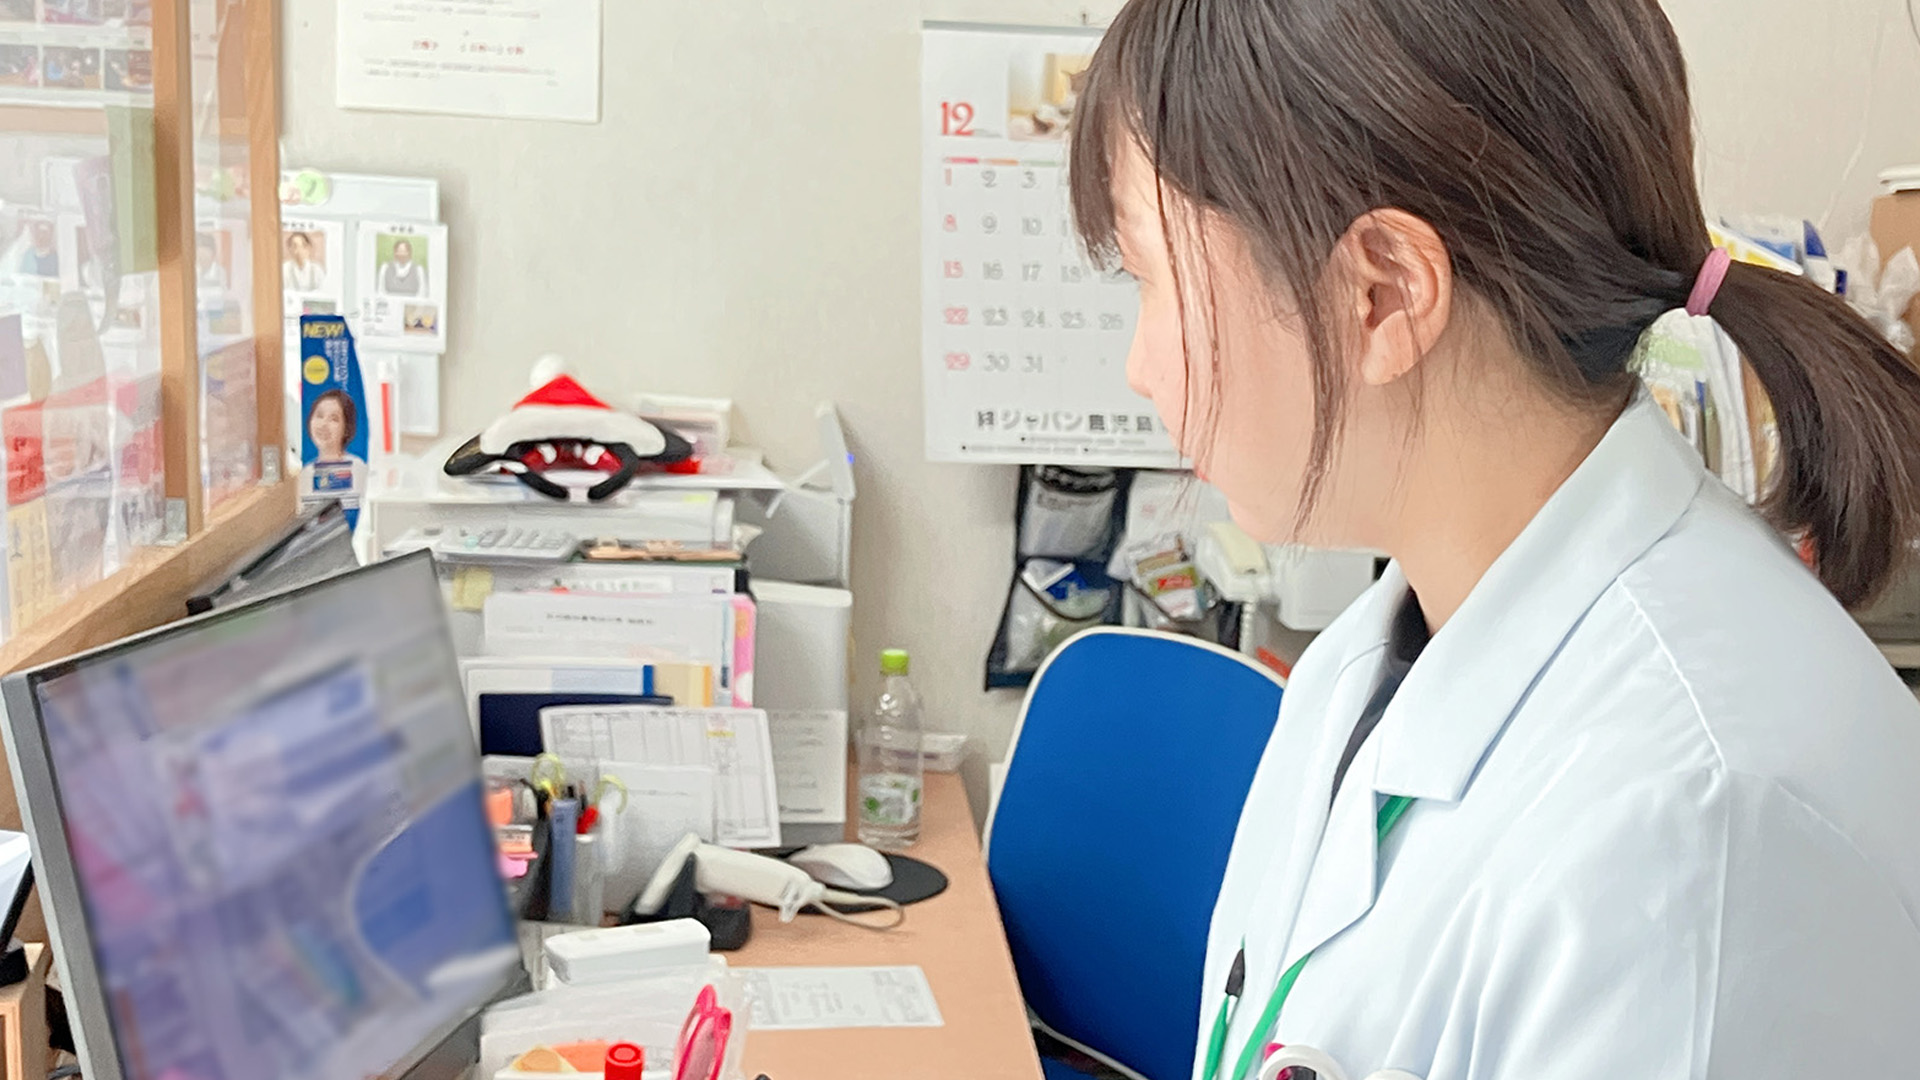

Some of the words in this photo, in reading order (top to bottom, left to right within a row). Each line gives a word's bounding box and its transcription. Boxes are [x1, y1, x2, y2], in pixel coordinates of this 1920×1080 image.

[941, 101, 975, 136] 12
[944, 168, 952, 187] 1
[981, 169, 997, 188] 2
[1021, 170, 1037, 189] 3
[981, 215, 997, 234] 9
[1022, 217, 1042, 236] 10
[983, 262, 1003, 280] 16
[1022, 263, 1042, 282] 17
[983, 308, 1008, 326] 23
[1021, 310, 1046, 328] 24
[984, 354, 1010, 372] 30
[1022, 355, 1044, 373] 31
